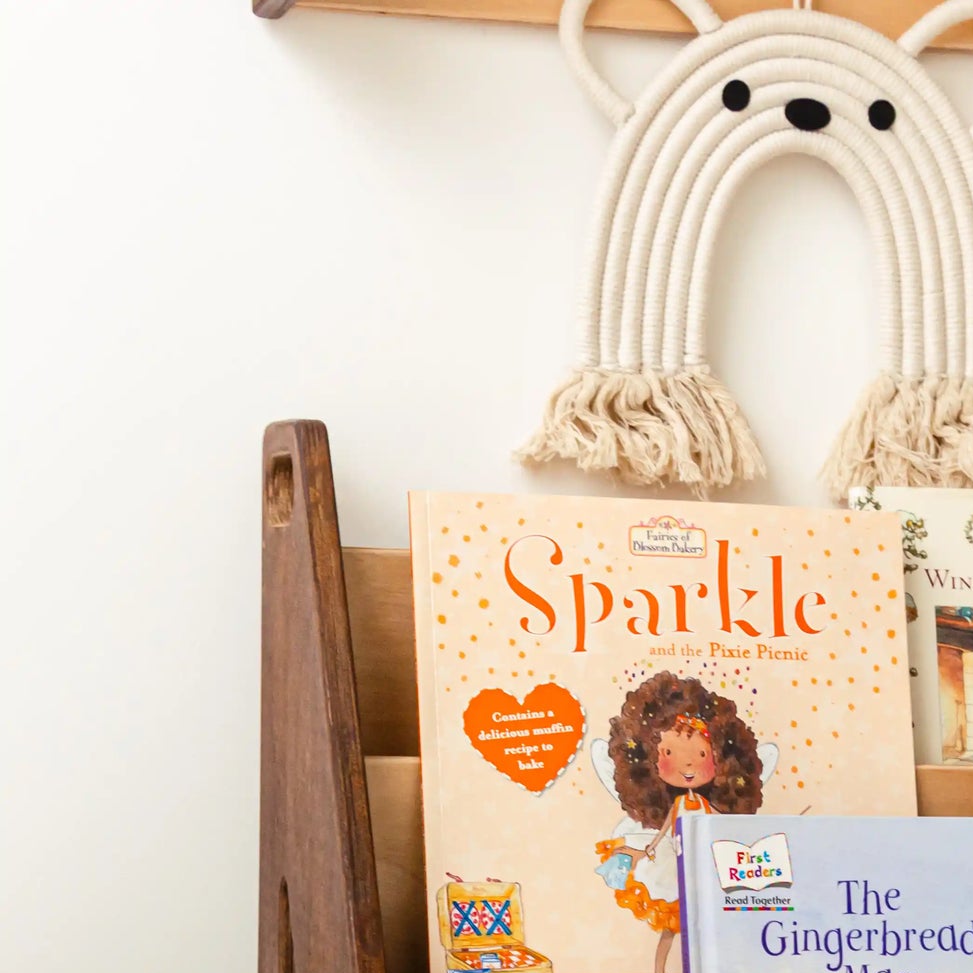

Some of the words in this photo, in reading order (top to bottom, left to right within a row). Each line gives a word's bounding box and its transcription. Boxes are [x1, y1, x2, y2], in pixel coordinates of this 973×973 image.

[646, 529, 679, 541] Fairies
[680, 531, 692, 542] of
[632, 540, 671, 553] Blossom
[671, 542, 704, 556] Bakery
[503, 534, 827, 653] Sparkle
[649, 643, 676, 657] and
[680, 644, 702, 657] the
[709, 642, 750, 658] Pixie
[756, 643, 809, 661] Picnic
[491, 710, 545, 722] Contains
[547, 710, 555, 718] a
[478, 728, 530, 740] delicious
[532, 722, 574, 736] muffin
[503, 743, 539, 756] recipe
[541, 743, 554, 751] to
[517, 759, 545, 770] bake
[736, 850, 771, 865] First
[729, 865, 783, 881] Readers
[724, 895, 749, 905] Read
[750, 895, 792, 907] Together
[837, 880, 901, 915] The
